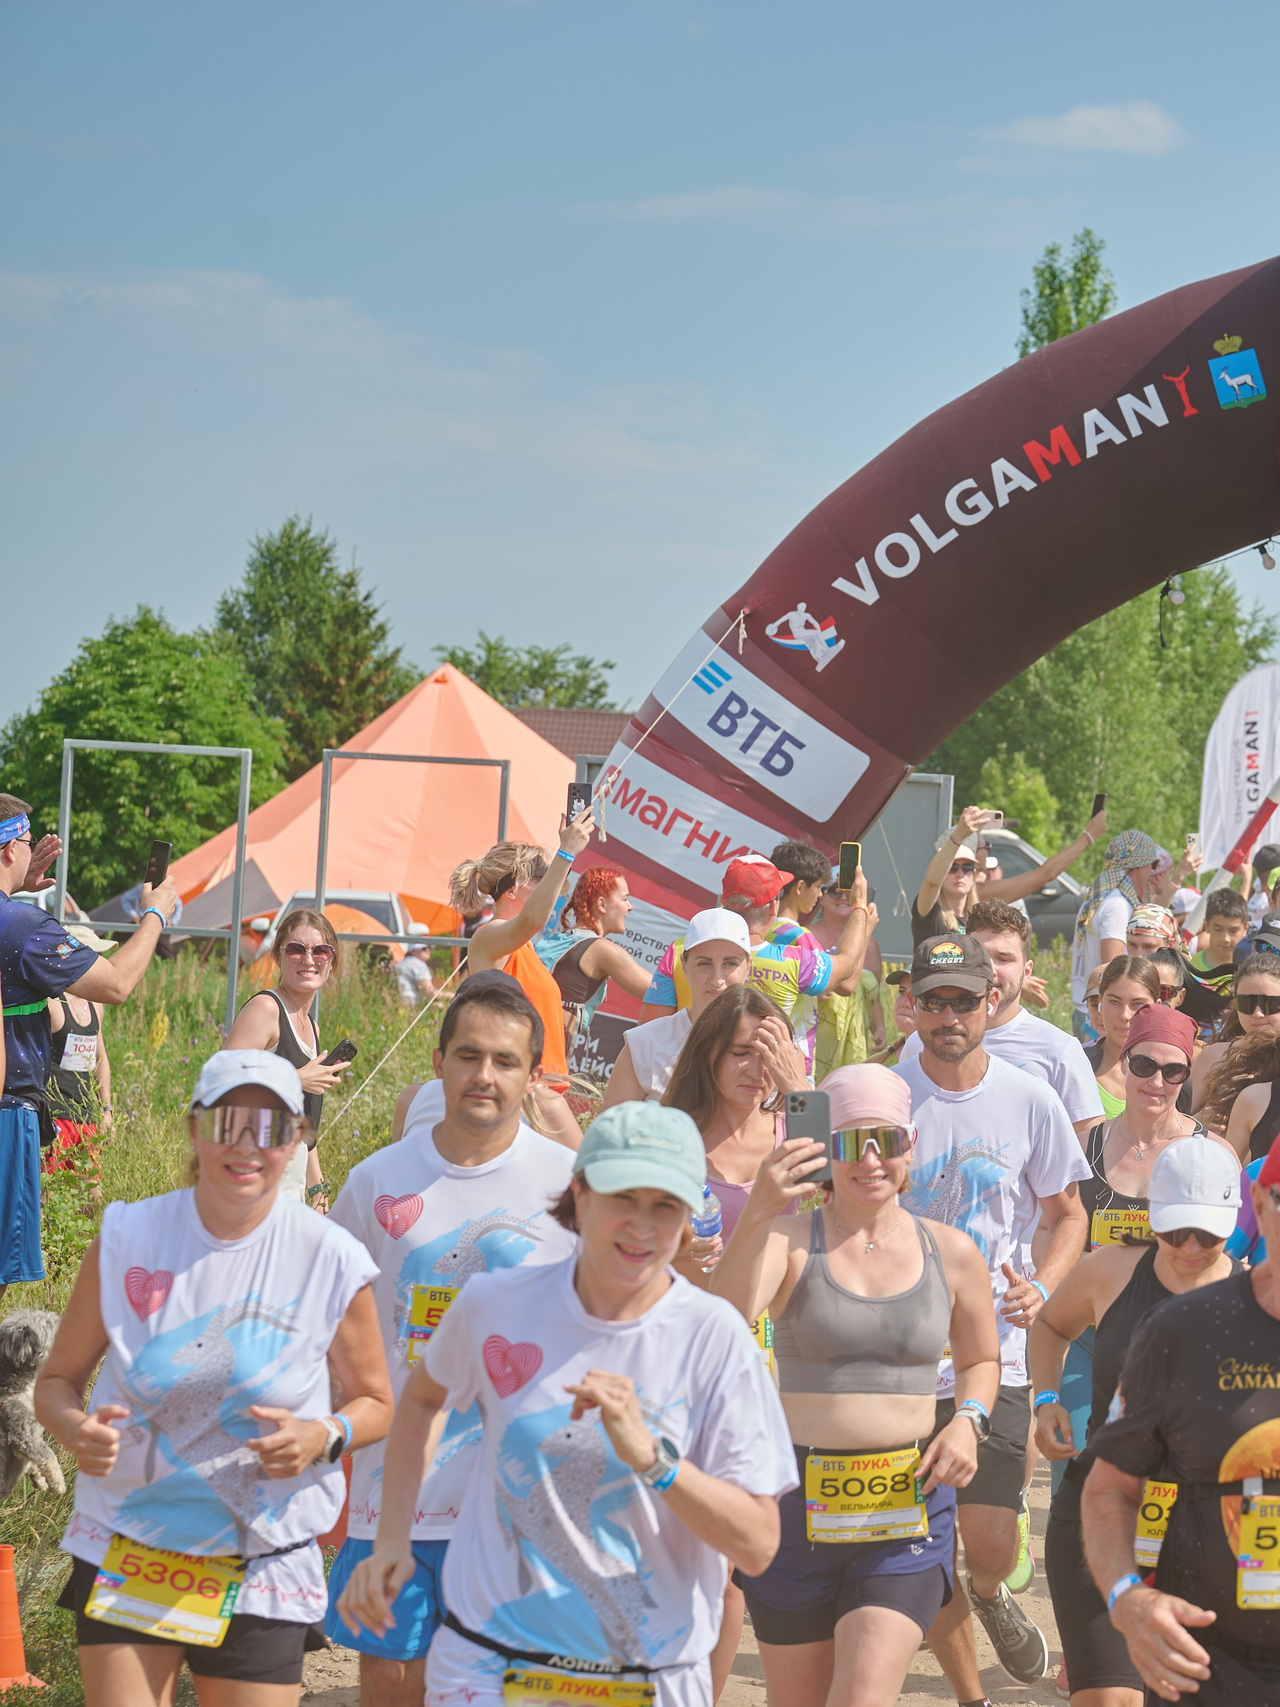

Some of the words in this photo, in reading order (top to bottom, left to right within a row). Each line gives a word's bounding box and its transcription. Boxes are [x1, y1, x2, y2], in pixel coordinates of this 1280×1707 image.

[832, 384, 1170, 606] VOLGAMAN
[707, 690, 806, 777] ВТБ
[625, 928, 670, 952] ерство
[749, 966, 790, 984] ЬТРА
[1104, 1213, 1120, 1221] ВТБ
[430, 1291, 451, 1302] ВТБ
[823, 1461, 845, 1472] ВТБ
[850, 1458, 890, 1472] ЛУКА
[820, 1473, 911, 1497] 5068
[840, 1501, 893, 1511] ВЕЛЬМИРА
[119, 1553, 222, 1599] 5306
[524, 1677, 552, 1691] ВТБ
[558, 1682, 610, 1697] ЛУКА
